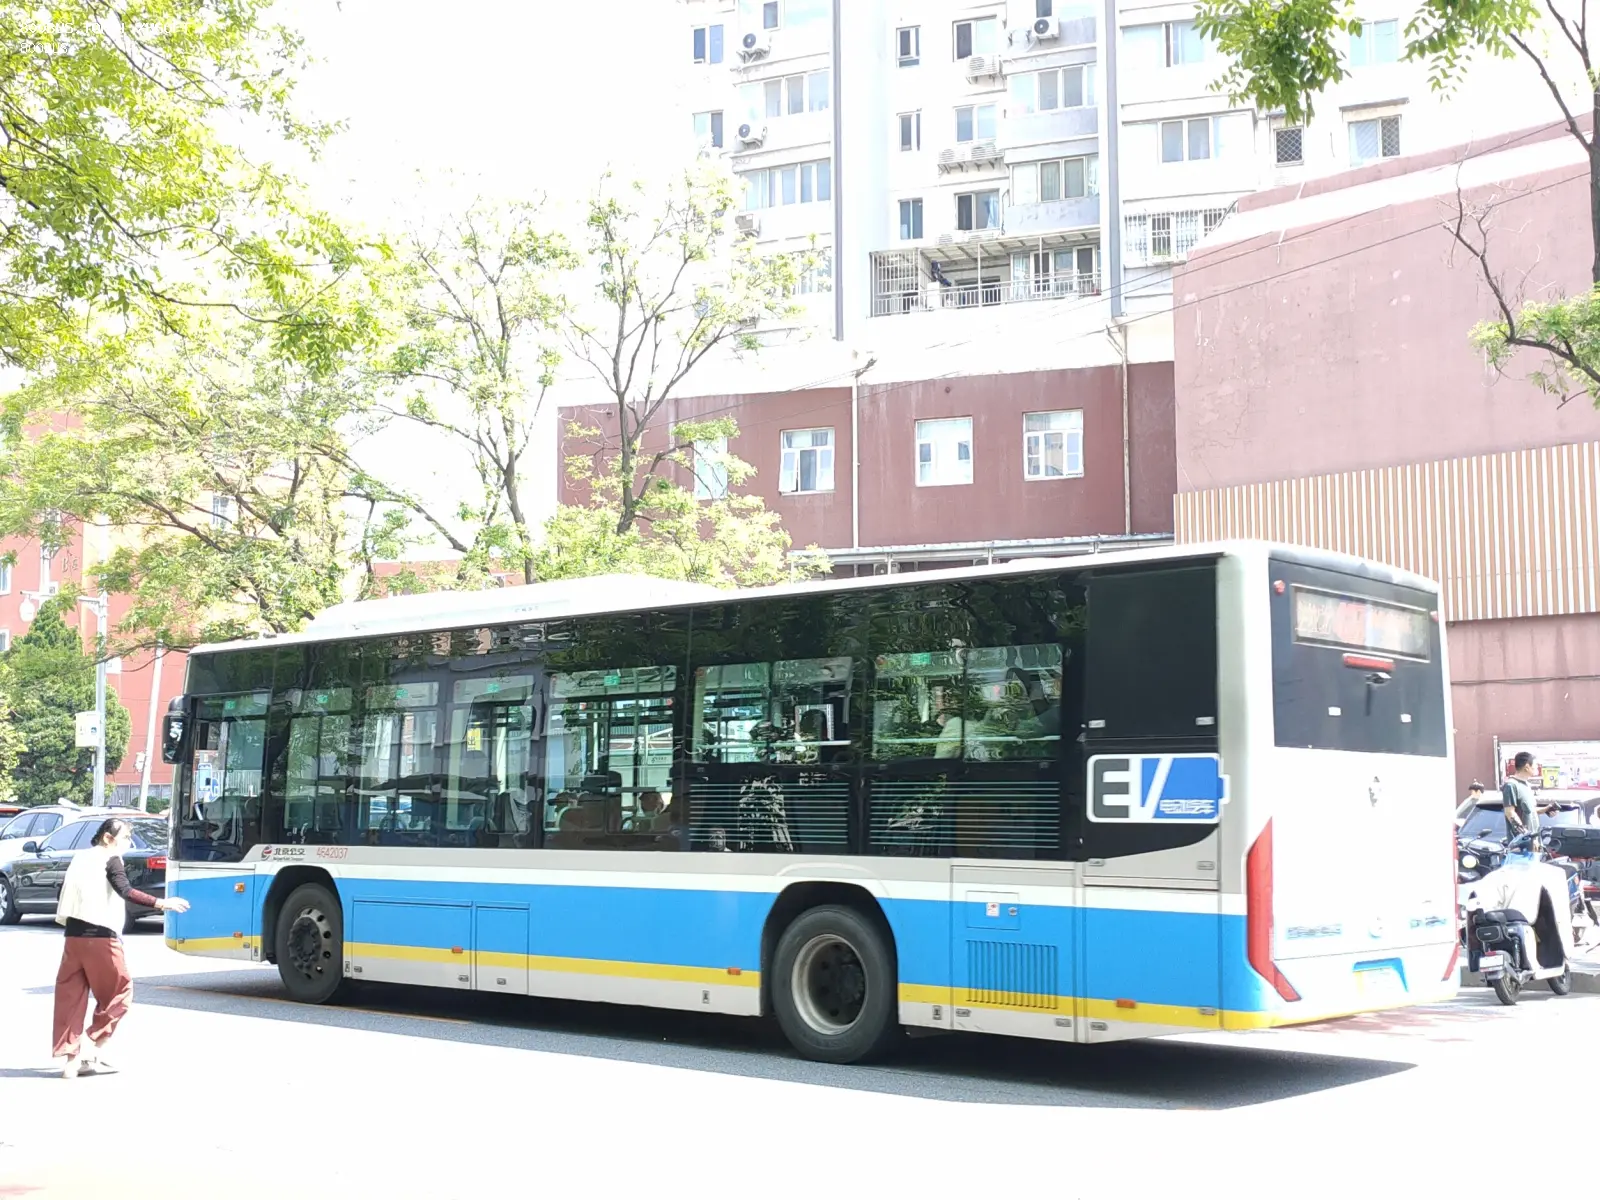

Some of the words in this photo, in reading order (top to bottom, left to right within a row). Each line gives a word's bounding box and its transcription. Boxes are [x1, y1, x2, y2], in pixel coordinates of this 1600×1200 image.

[1093, 758, 1173, 819] EV
[273, 847, 306, 856] 北京公交
